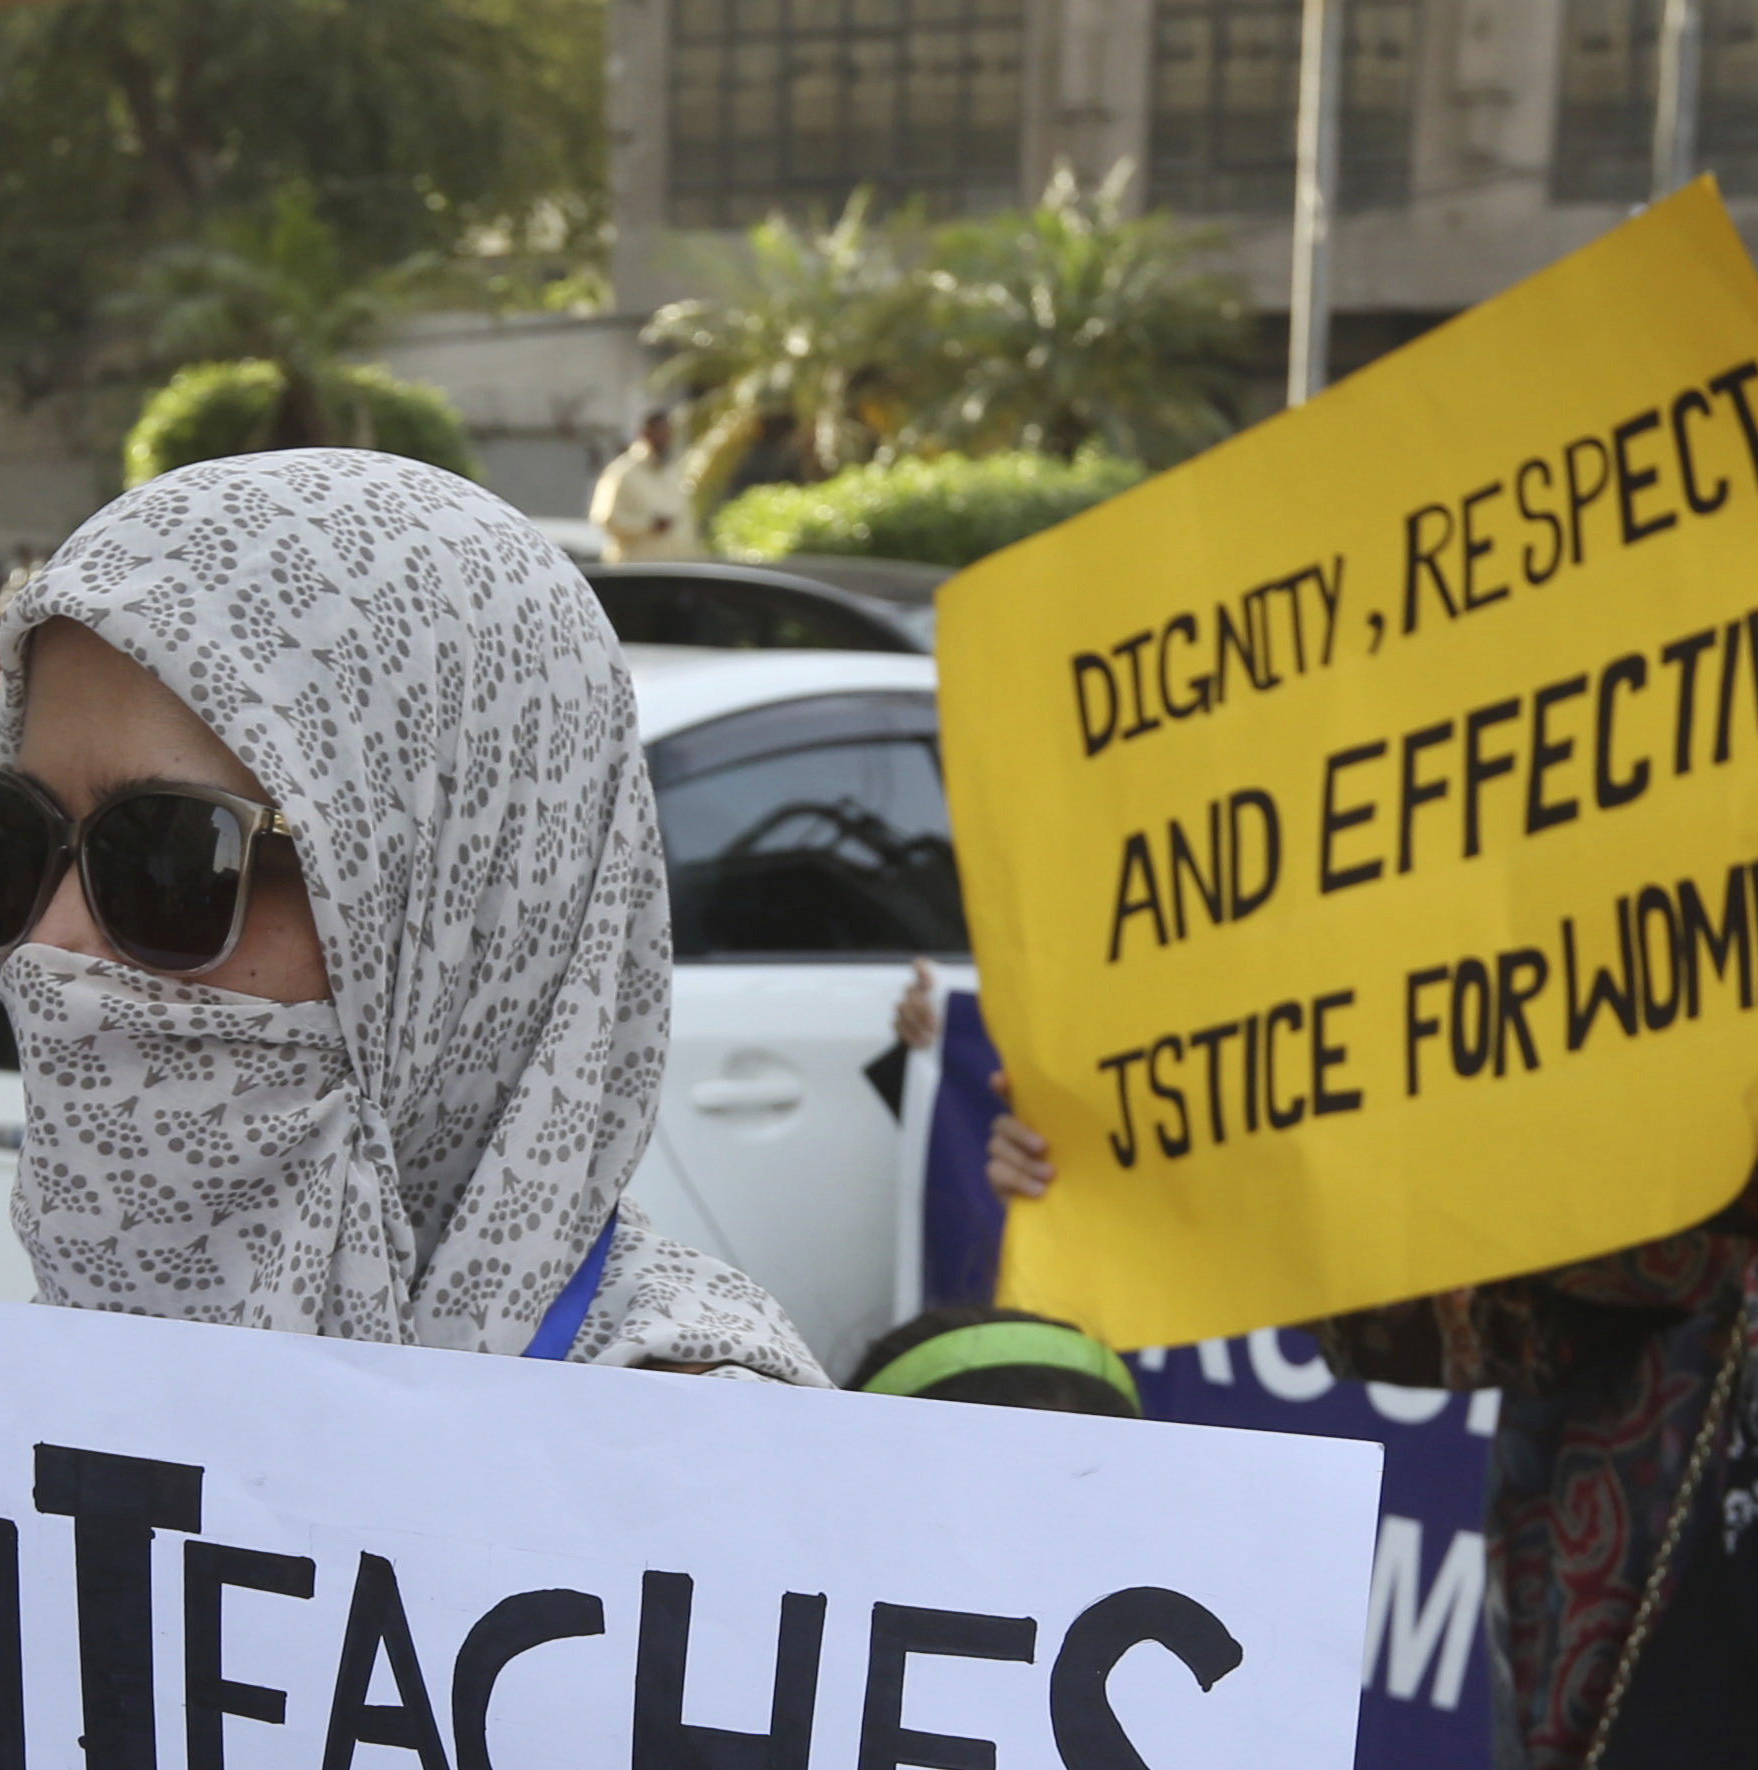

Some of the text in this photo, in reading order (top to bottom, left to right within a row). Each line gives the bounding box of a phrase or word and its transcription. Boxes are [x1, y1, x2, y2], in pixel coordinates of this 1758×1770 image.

[1072, 553, 1387, 759] DIGNITY,
[1108, 787, 1281, 964] AND
[1098, 990, 1364, 1169] JSTICE
[1405, 947, 1550, 1099] FOR
